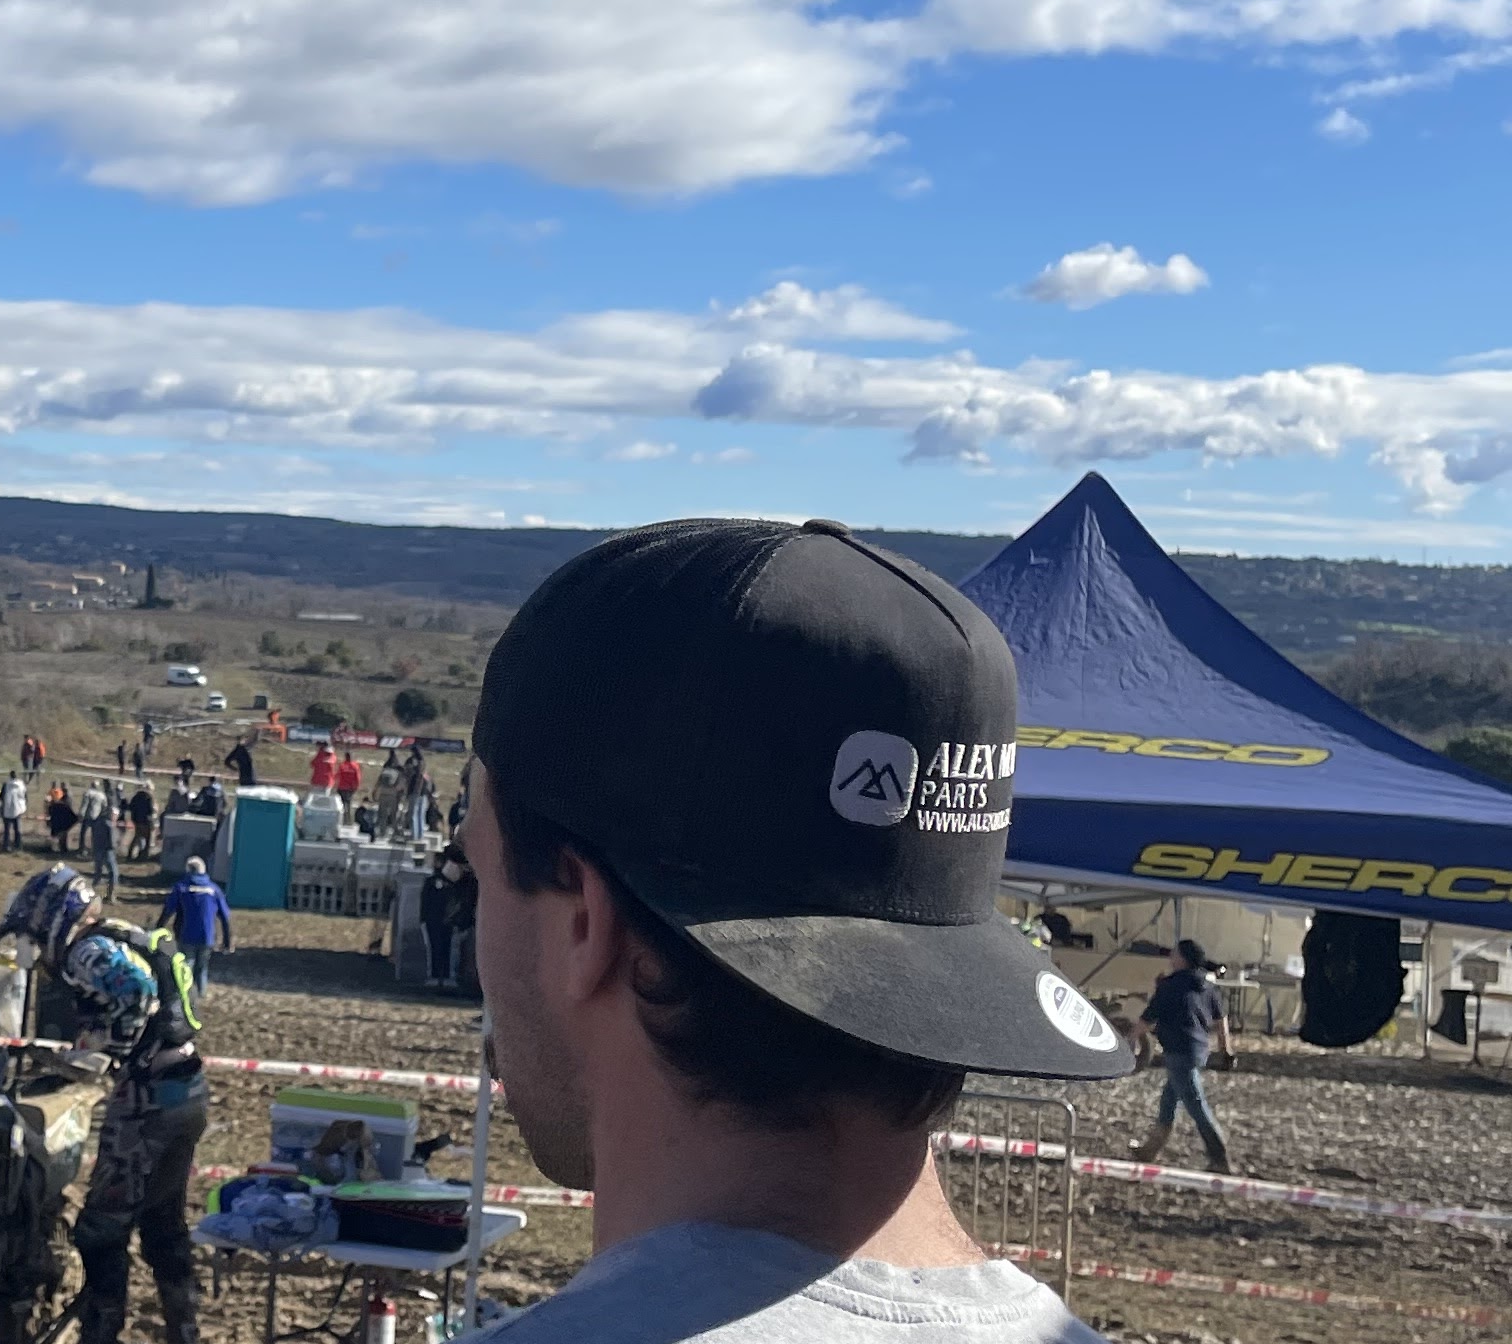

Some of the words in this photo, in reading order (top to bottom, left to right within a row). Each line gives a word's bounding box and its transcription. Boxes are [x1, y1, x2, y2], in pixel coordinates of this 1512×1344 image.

[925, 741, 998, 781] ALEX
[1014, 725, 1334, 767] ERCO
[919, 780, 989, 810] PARTS
[1131, 842, 1512, 903] SHERC
